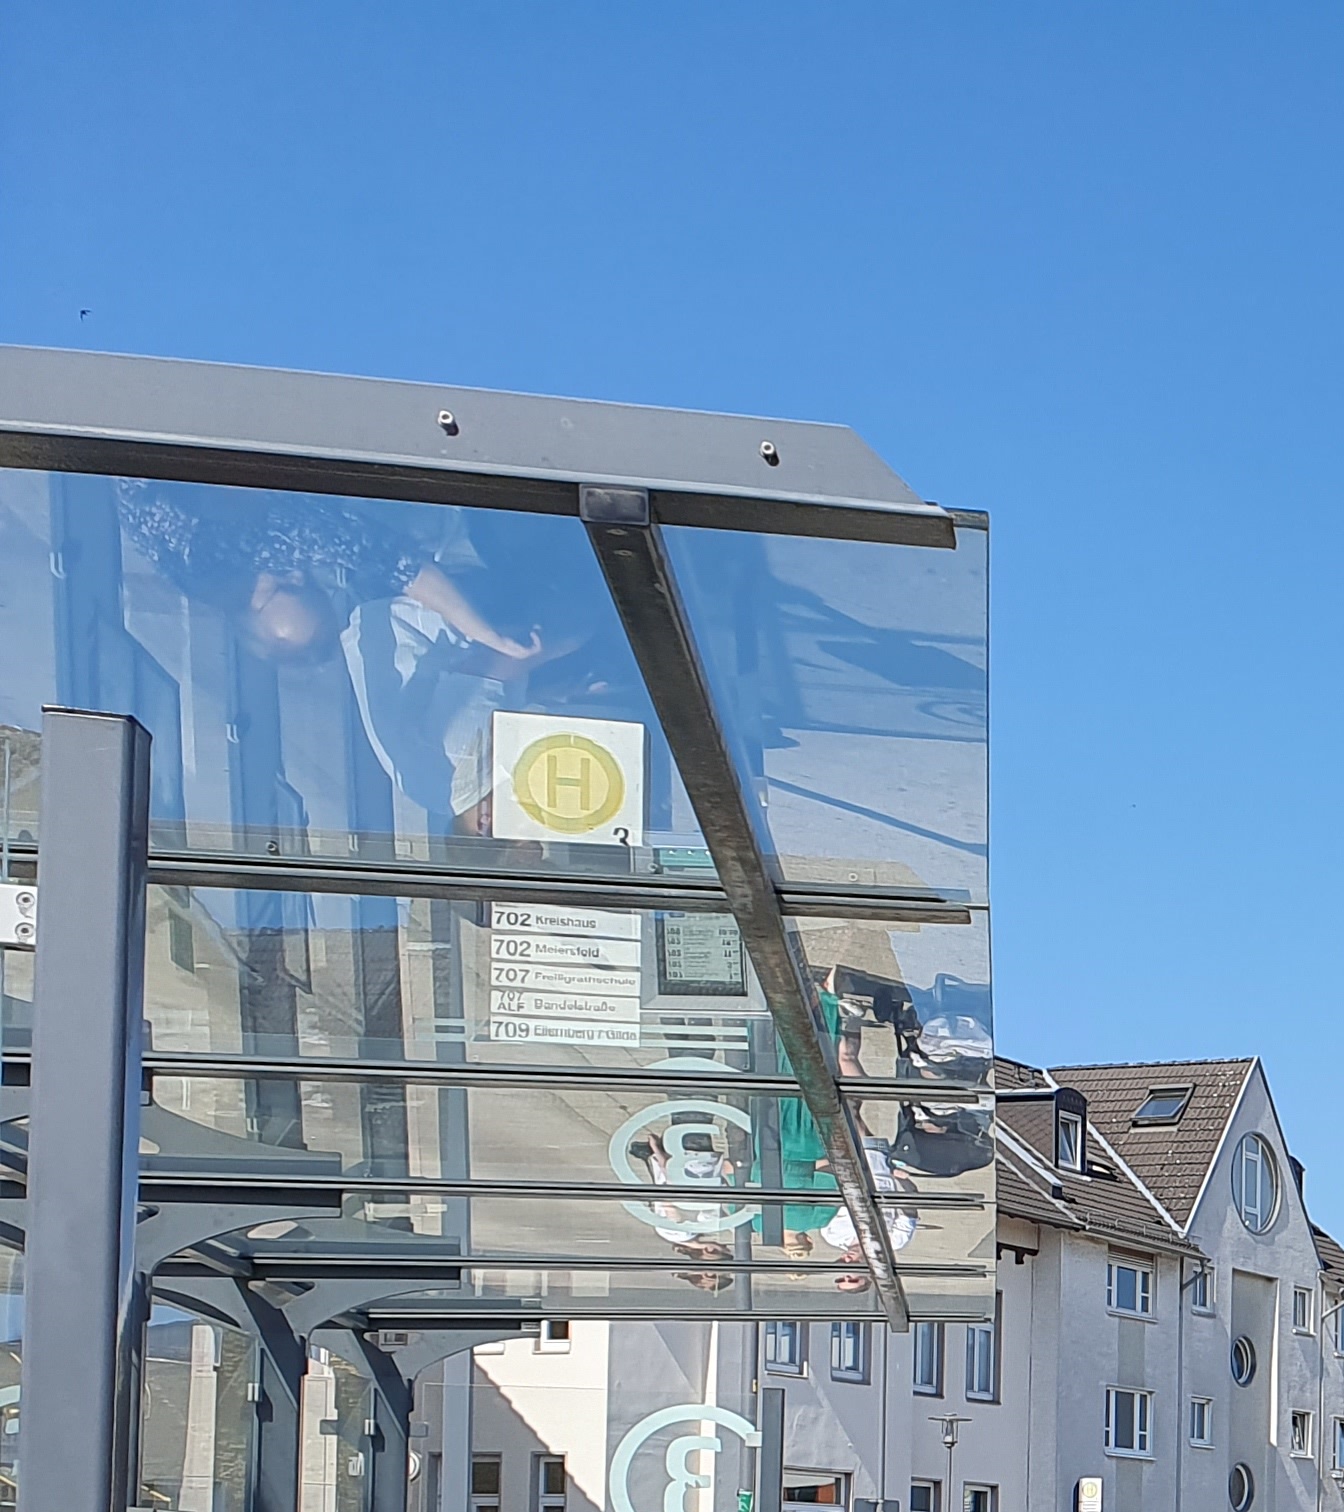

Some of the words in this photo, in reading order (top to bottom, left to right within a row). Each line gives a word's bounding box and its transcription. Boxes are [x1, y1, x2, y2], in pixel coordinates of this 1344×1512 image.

[547, 754, 590, 811] H
[494, 911, 532, 927] 702
[535, 915, 597, 929] Kreishaus
[493, 939, 531, 957] 702
[535, 944, 600, 958] Meiersfeld
[493, 967, 530, 984] 707
[497, 1002, 526, 1012] ALF
[492, 1021, 530, 1039] 709
